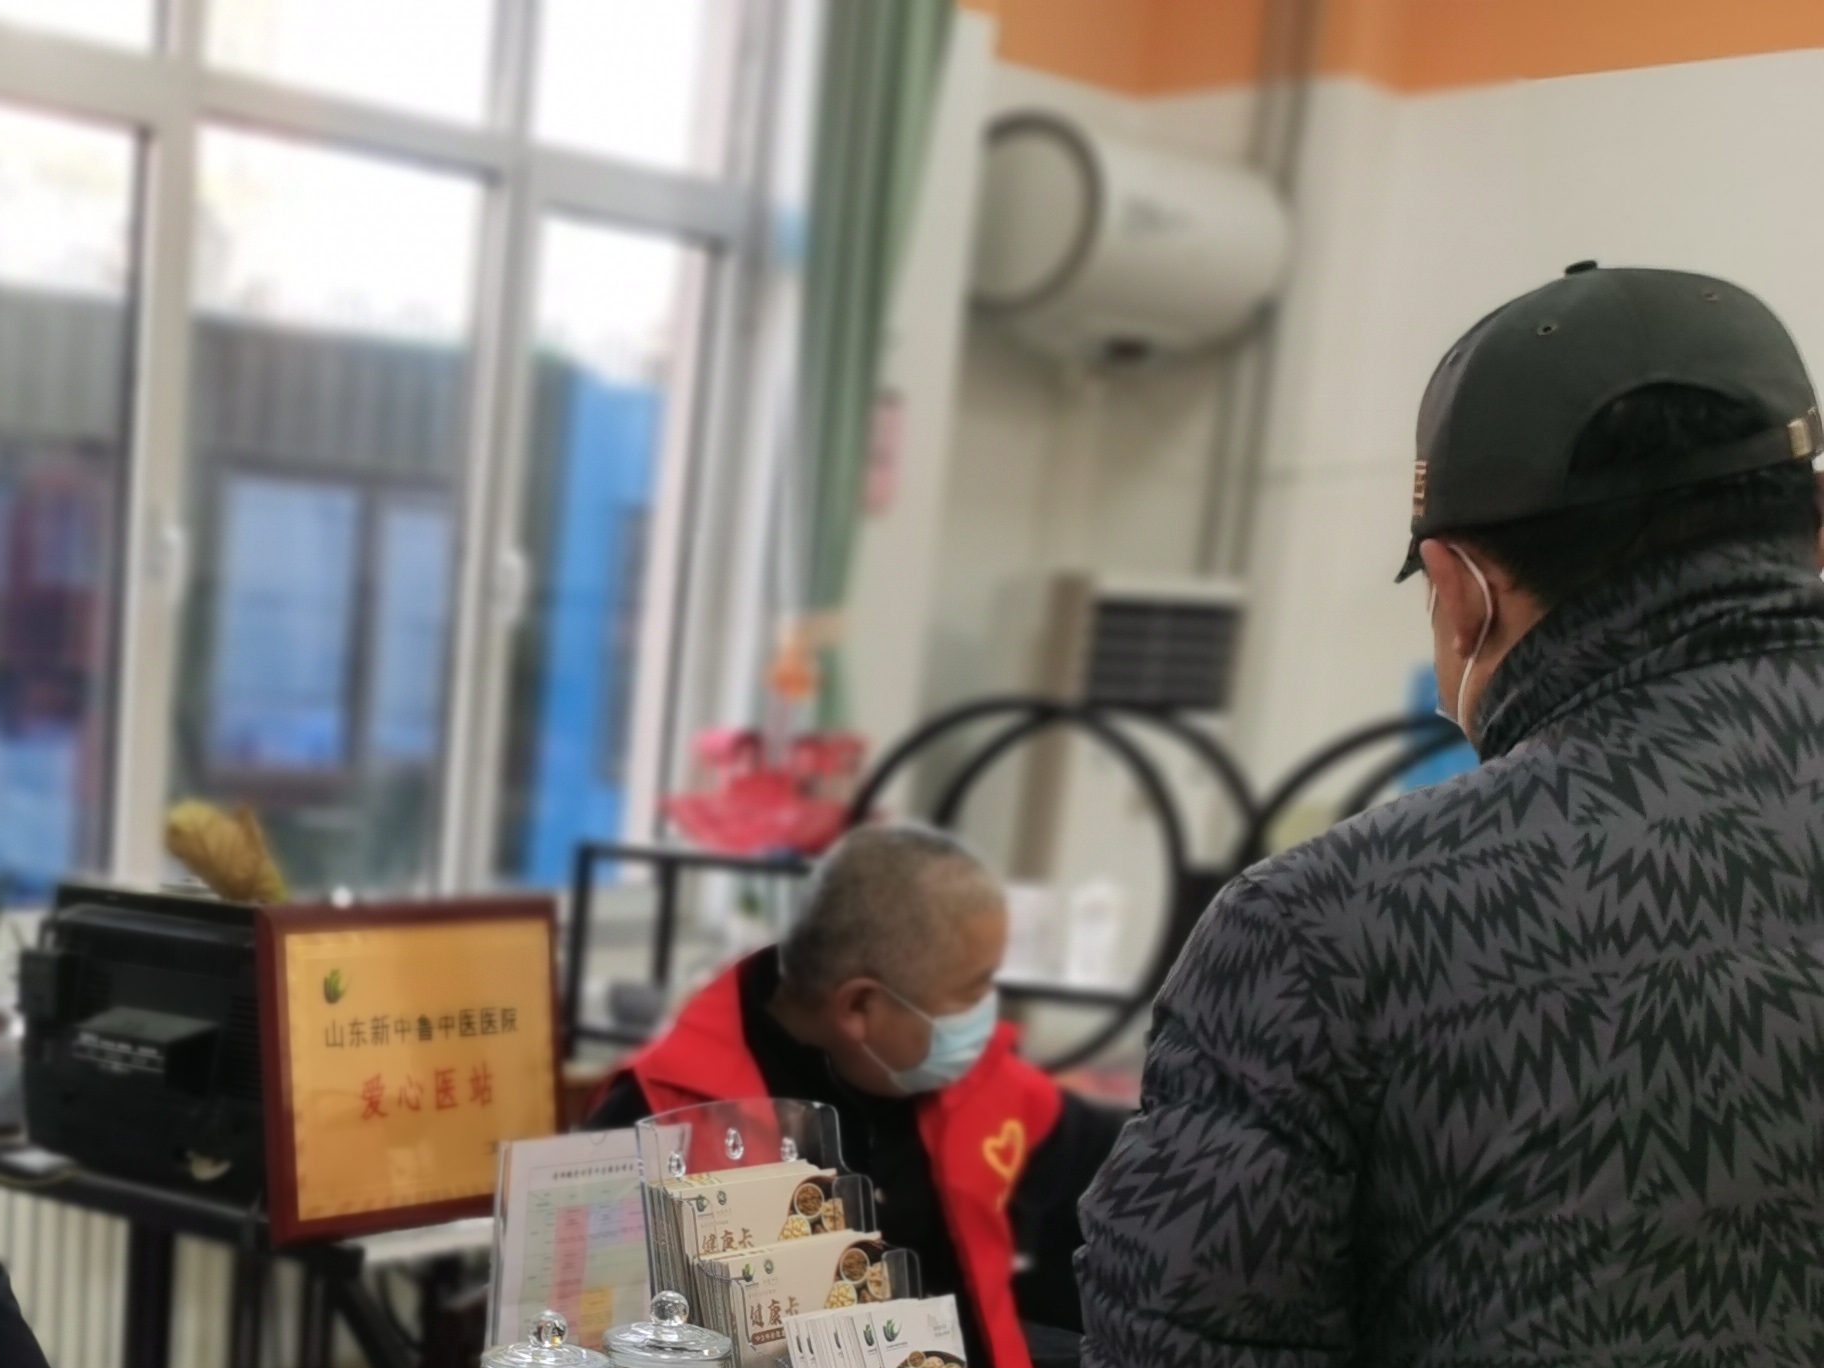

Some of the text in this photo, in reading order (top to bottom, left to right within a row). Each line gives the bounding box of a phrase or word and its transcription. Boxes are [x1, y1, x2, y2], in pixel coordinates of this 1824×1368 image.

[325, 1007, 518, 1049] 山东新中鲁中医医院
[360, 1060, 494, 1121] 爱心医站
[701, 1227, 755, 1252] 健康卡
